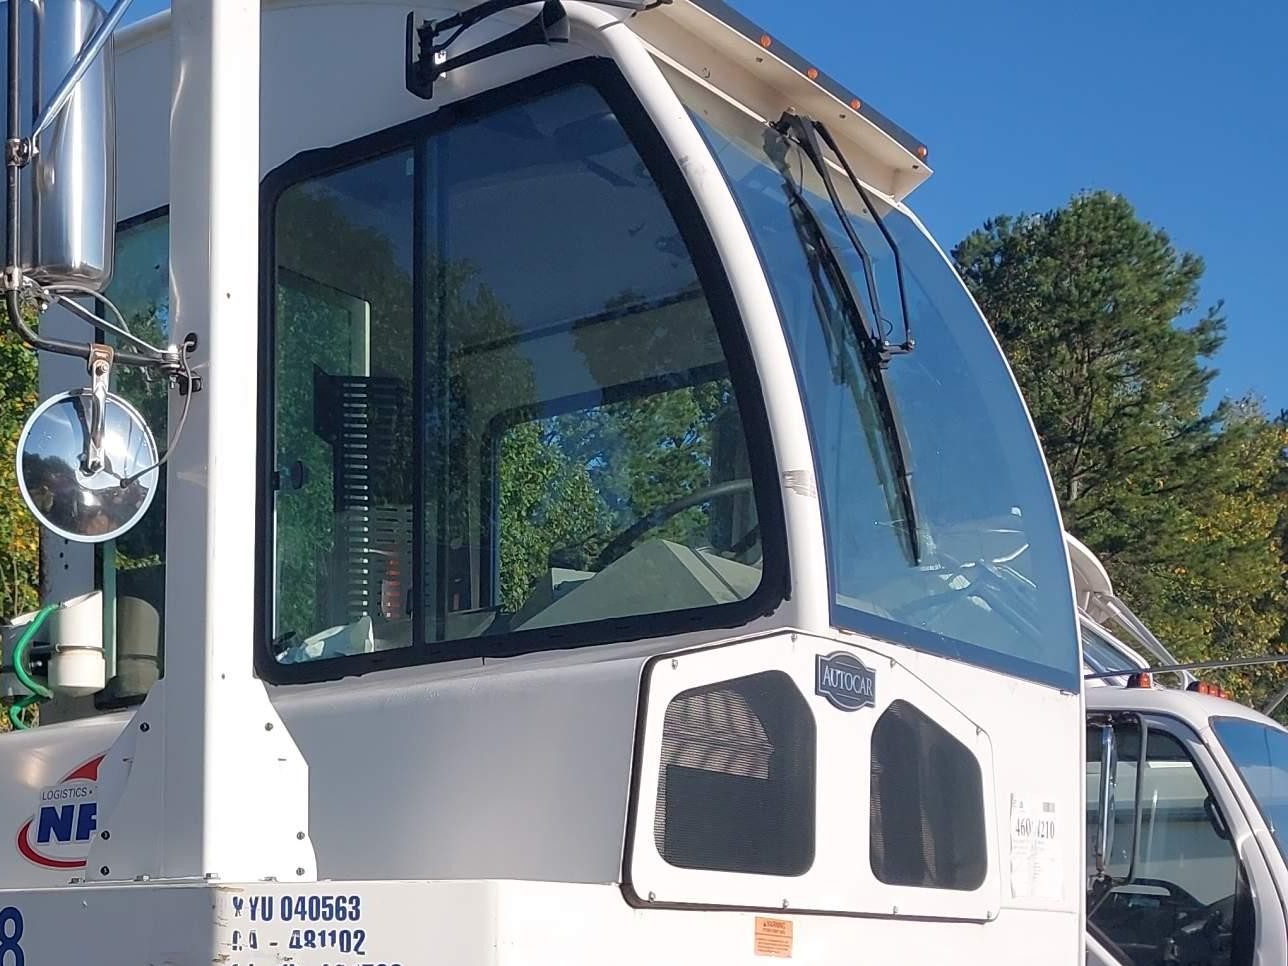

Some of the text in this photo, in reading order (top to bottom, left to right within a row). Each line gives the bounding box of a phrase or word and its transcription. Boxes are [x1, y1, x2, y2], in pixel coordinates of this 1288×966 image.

[822, 665, 873, 697] AUTOCAR
[42, 787, 88, 801] LOGISTICS
[280, 896, 362, 921] 040563
[289, 929, 366, 955] 481102
